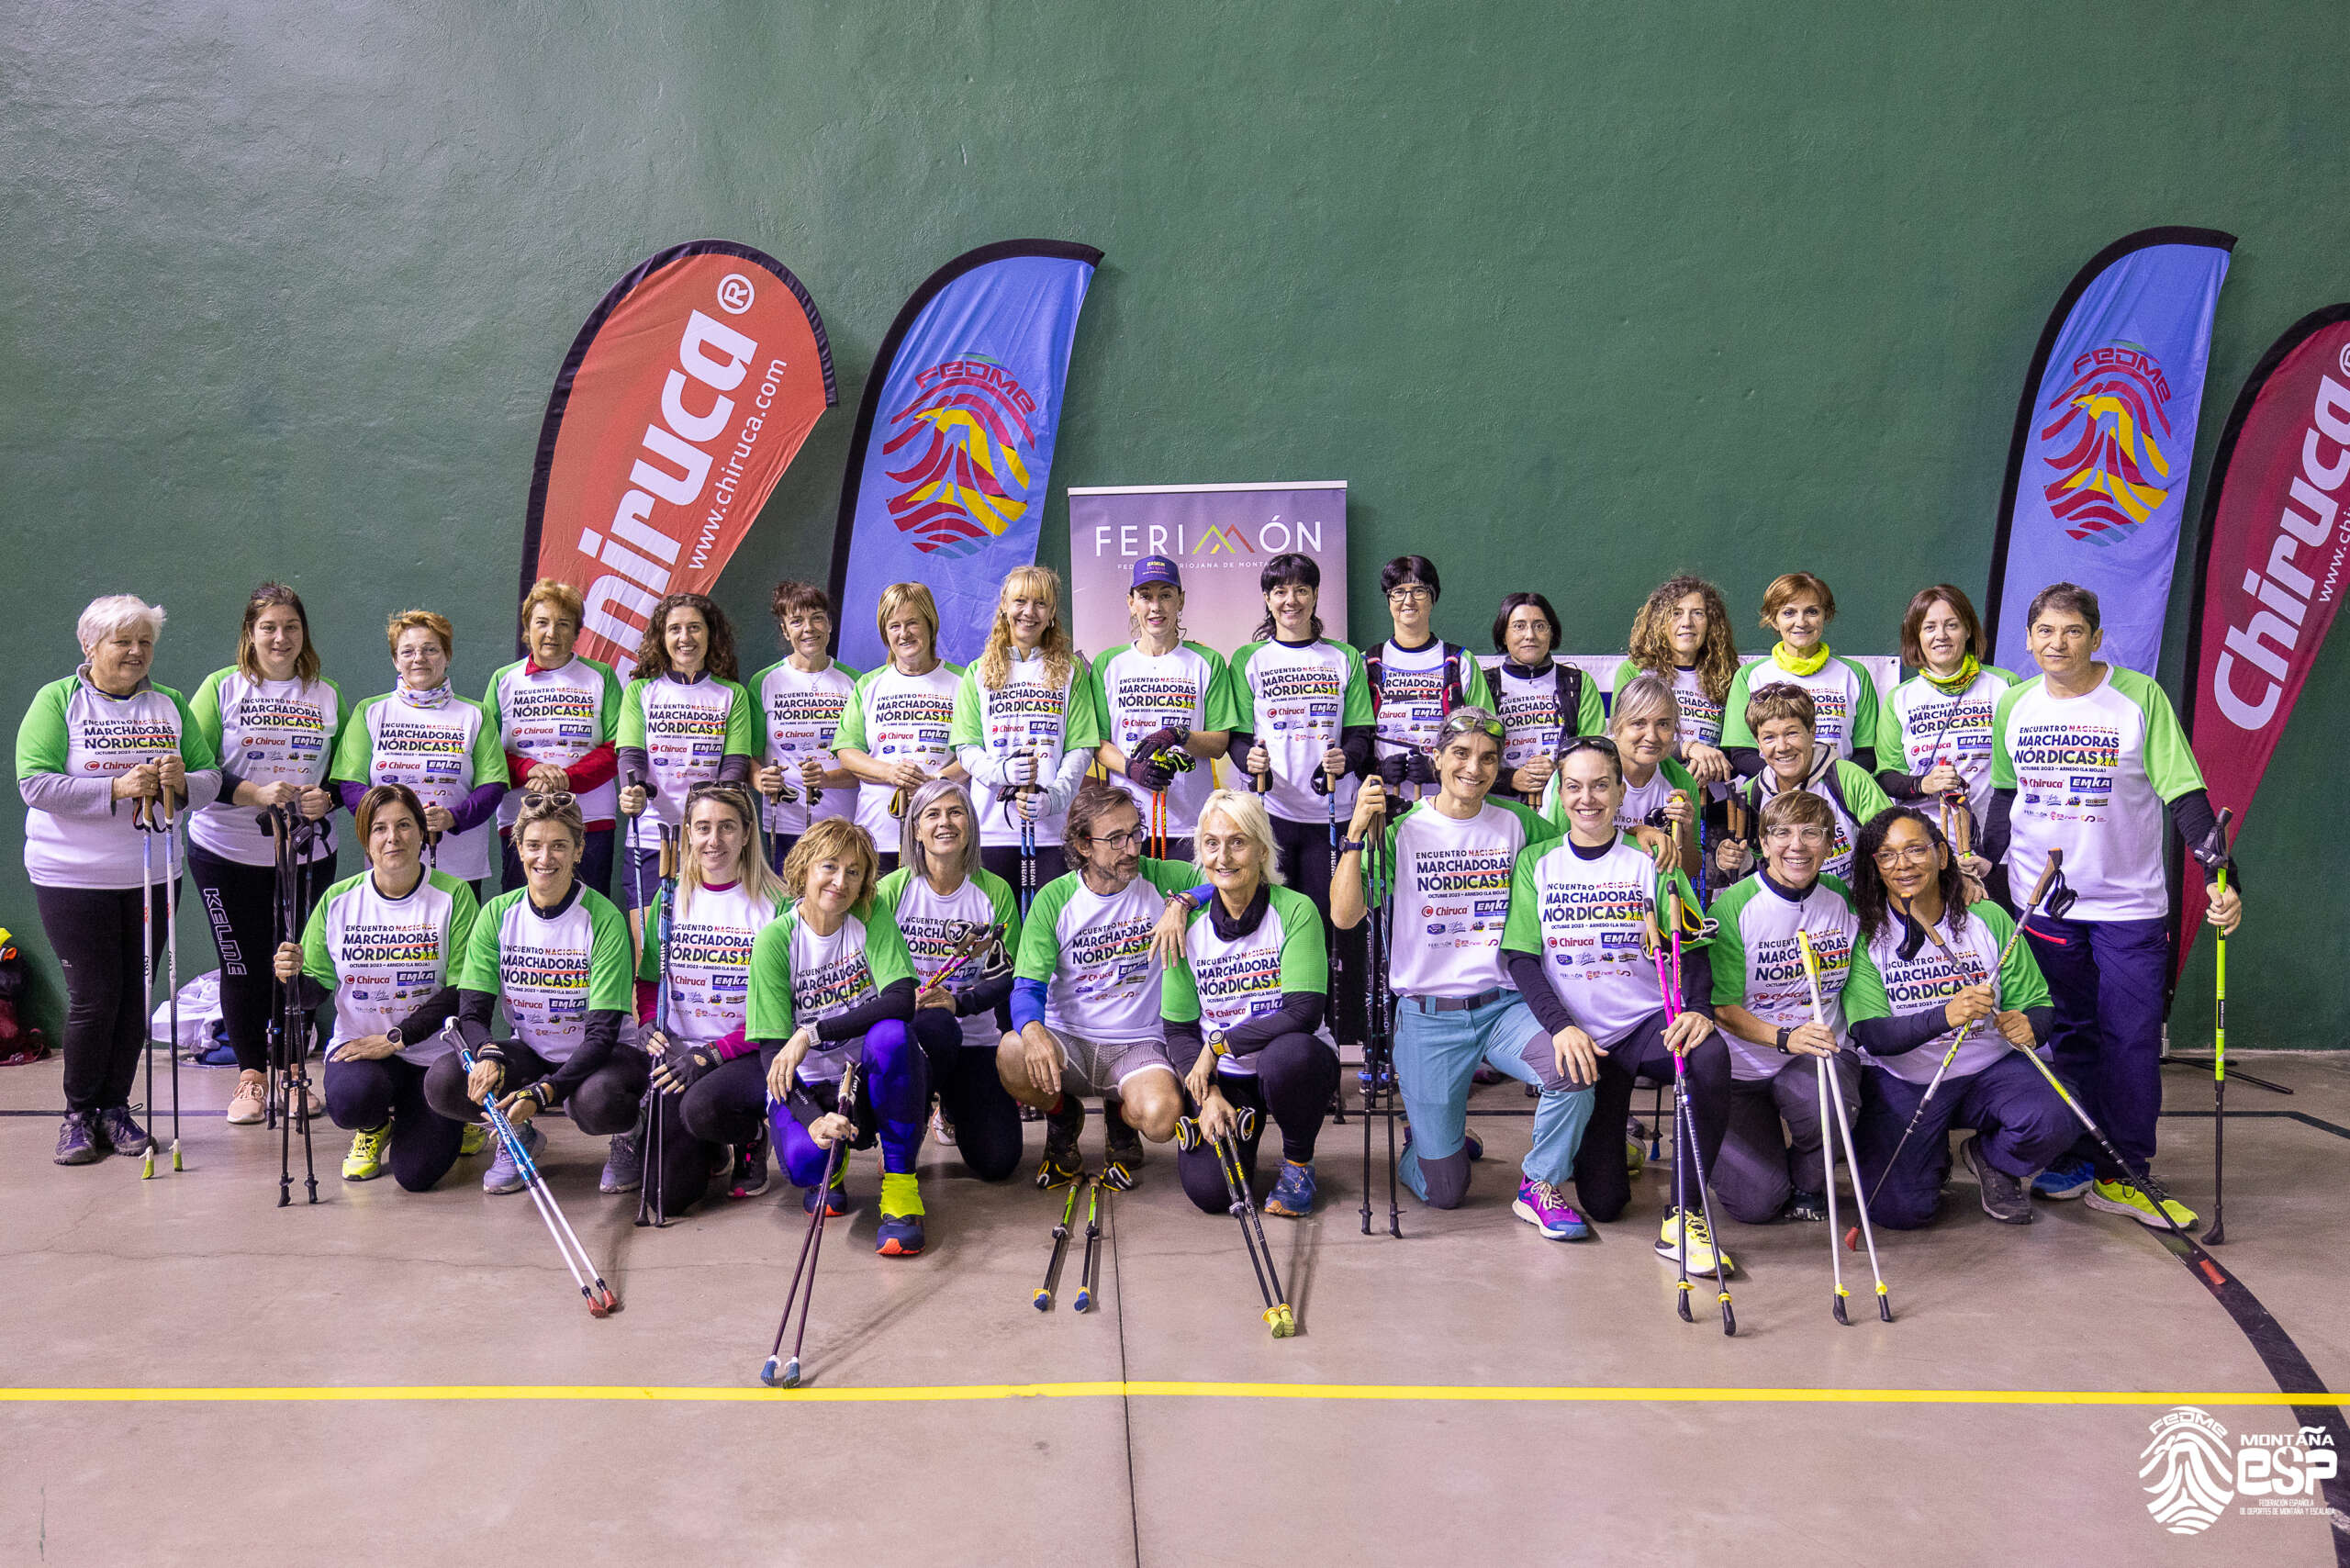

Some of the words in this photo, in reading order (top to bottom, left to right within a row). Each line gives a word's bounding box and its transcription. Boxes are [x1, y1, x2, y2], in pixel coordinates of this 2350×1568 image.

[688, 359, 788, 570] www.chiruca.com
[578, 308, 758, 695] hiruca
[1260, 666, 1303, 678] ENCUENTRO
[1262, 673, 1340, 688] MARCHADORAS
[514, 688, 556, 696] ENCUENTRO
[1119, 684, 1197, 695] MARCHADORAS
[1262, 683, 1329, 699] NÓRDICAS
[513, 694, 594, 705] MARCHADORAS
[877, 700, 954, 711] MARCHADORAS
[1118, 694, 1182, 708] NÓRDICAS
[241, 704, 323, 719] MARCHADORAS
[512, 704, 580, 718] NÓRDICAS
[648, 711, 726, 722] MARCHADORAS
[774, 708, 841, 720] NÓRDICAS
[875, 710, 940, 723] NÓRDICAS
[1278, 707, 1305, 716] Chiruca
[1311, 704, 1338, 713] EMKA
[1379, 711, 1407, 720] Chiruca
[1909, 705, 1993, 723] MARCHADORAS
[241, 713, 313, 728] NÓRDICAS
[648, 719, 714, 734] NÓRDICAS
[1163, 718, 1192, 727] EMKA
[84, 725, 174, 736] MARCHADORAS
[524, 726, 554, 734] Chiruca
[1000, 724, 1024, 733] Chiruca
[1030, 722, 1058, 732] EMKA
[2019, 725, 2067, 734] ENCUENTRO
[255, 736, 286, 745] Chiruca
[380, 730, 465, 741] MARCHADORAS
[888, 732, 914, 740] Chiruca
[920, 730, 949, 740] EMKA
[2017, 734, 2120, 748] MARCHADORAS
[84, 735, 166, 749] NÓRDICAS
[377, 738, 450, 752] NÓRDICAS
[660, 744, 688, 753] Chiruca
[694, 744, 722, 753] EMKA
[1511, 738, 1538, 746] Chiruca
[2014, 747, 2098, 765] NÓRDICAS
[388, 761, 420, 769] Chiruca
[2029, 778, 2064, 789] Chiruca
[2071, 778, 2111, 789] EMKA
[1416, 850, 1467, 858] ENCUENTRO
[1416, 857, 1511, 873] MARCHADORAS
[1417, 873, 1498, 891] NÓRDICAS
[1546, 890, 1643, 905] MARCHADORAS
[1436, 907, 1468, 916] Chiruca
[1542, 904, 1627, 923] NÓRDICAS
[203, 887, 248, 977] KELME
[343, 932, 439, 945] MARCHADORAS
[1559, 937, 1595, 946] Chiruca
[1603, 933, 1640, 944] EMKA
[341, 945, 421, 961] NÓRDICAS
[500, 955, 588, 969] MARCHADORAS
[1197, 958, 1281, 979] MARCHADORAS
[356, 975, 390, 985] Chiruca
[398, 971, 435, 981] EMKA
[500, 967, 571, 988] NÓRDICAS
[675, 976, 706, 986] Chiruca
[1199, 974, 1271, 996] NÓRDICAS
[513, 999, 543, 1009] Chiruca
[551, 1000, 586, 1010] EMKA
[1216, 1007, 1246, 1018] Chiruca
